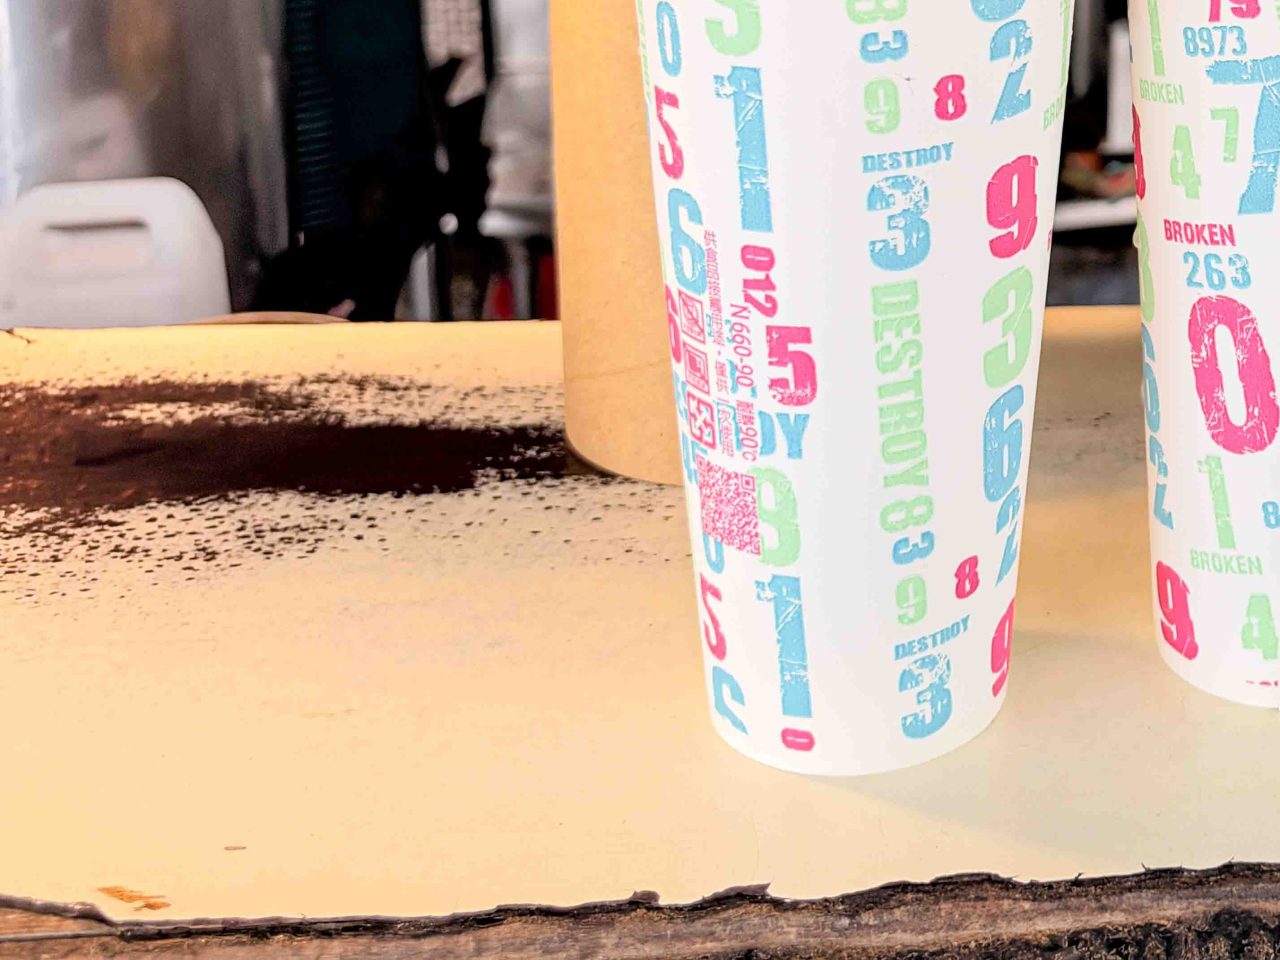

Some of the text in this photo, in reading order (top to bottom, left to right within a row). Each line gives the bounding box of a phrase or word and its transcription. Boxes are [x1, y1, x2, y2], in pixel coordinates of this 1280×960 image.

[1183, 25, 1247, 57] 8973
[933, 73, 968, 122] 8
[1141, 81, 1184, 104] BROKEN
[862, 141, 955, 174] DESTROY
[985, 154, 1039, 260] 9
[1163, 218, 1236, 247] BROKEN
[1183, 251, 1252, 301] 263
[1187, 294, 1280, 455] 0
[954, 555, 980, 600] 8
[1191, 550, 1263, 576] BROKEN
[894, 614, 970, 661] DESTROY
